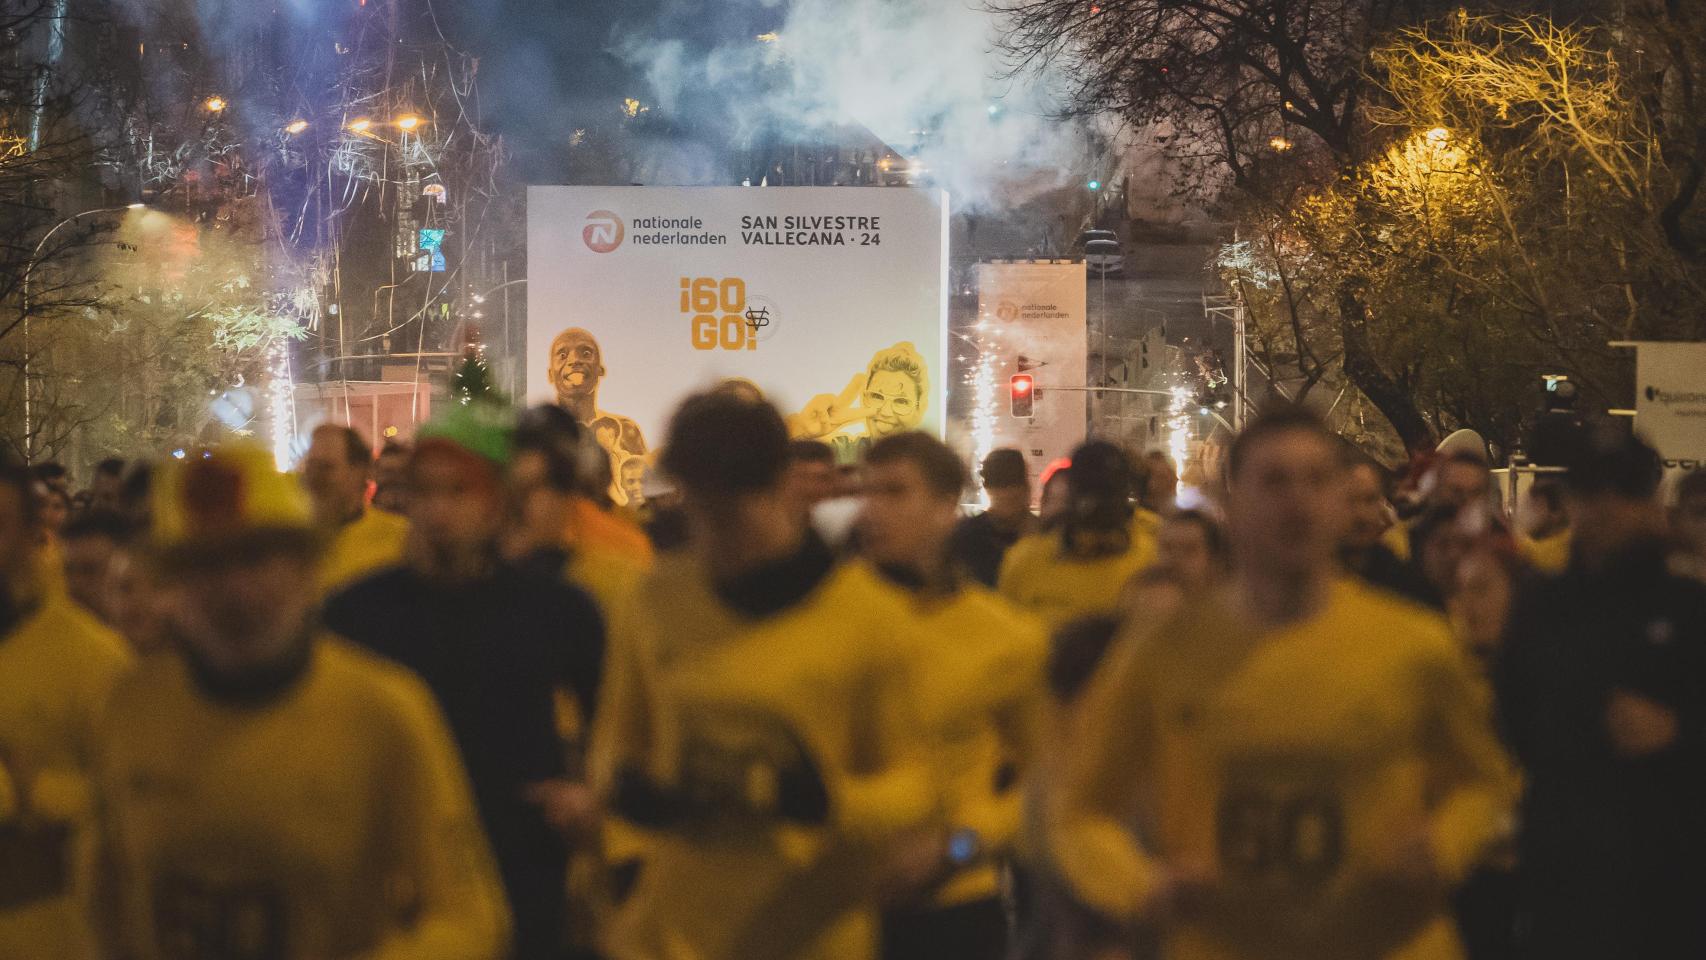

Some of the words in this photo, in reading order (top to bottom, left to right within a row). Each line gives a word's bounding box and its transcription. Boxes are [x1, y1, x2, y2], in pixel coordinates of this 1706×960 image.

[633, 216, 703, 229] nationale
[741, 216, 778, 229] SAN
[784, 216, 881, 230] SILVESTRE
[633, 232, 727, 245] nederlanden
[741, 232, 845, 245] VALLECANA
[860, 233, 881, 246] 24
[691, 314, 757, 351] GO!
